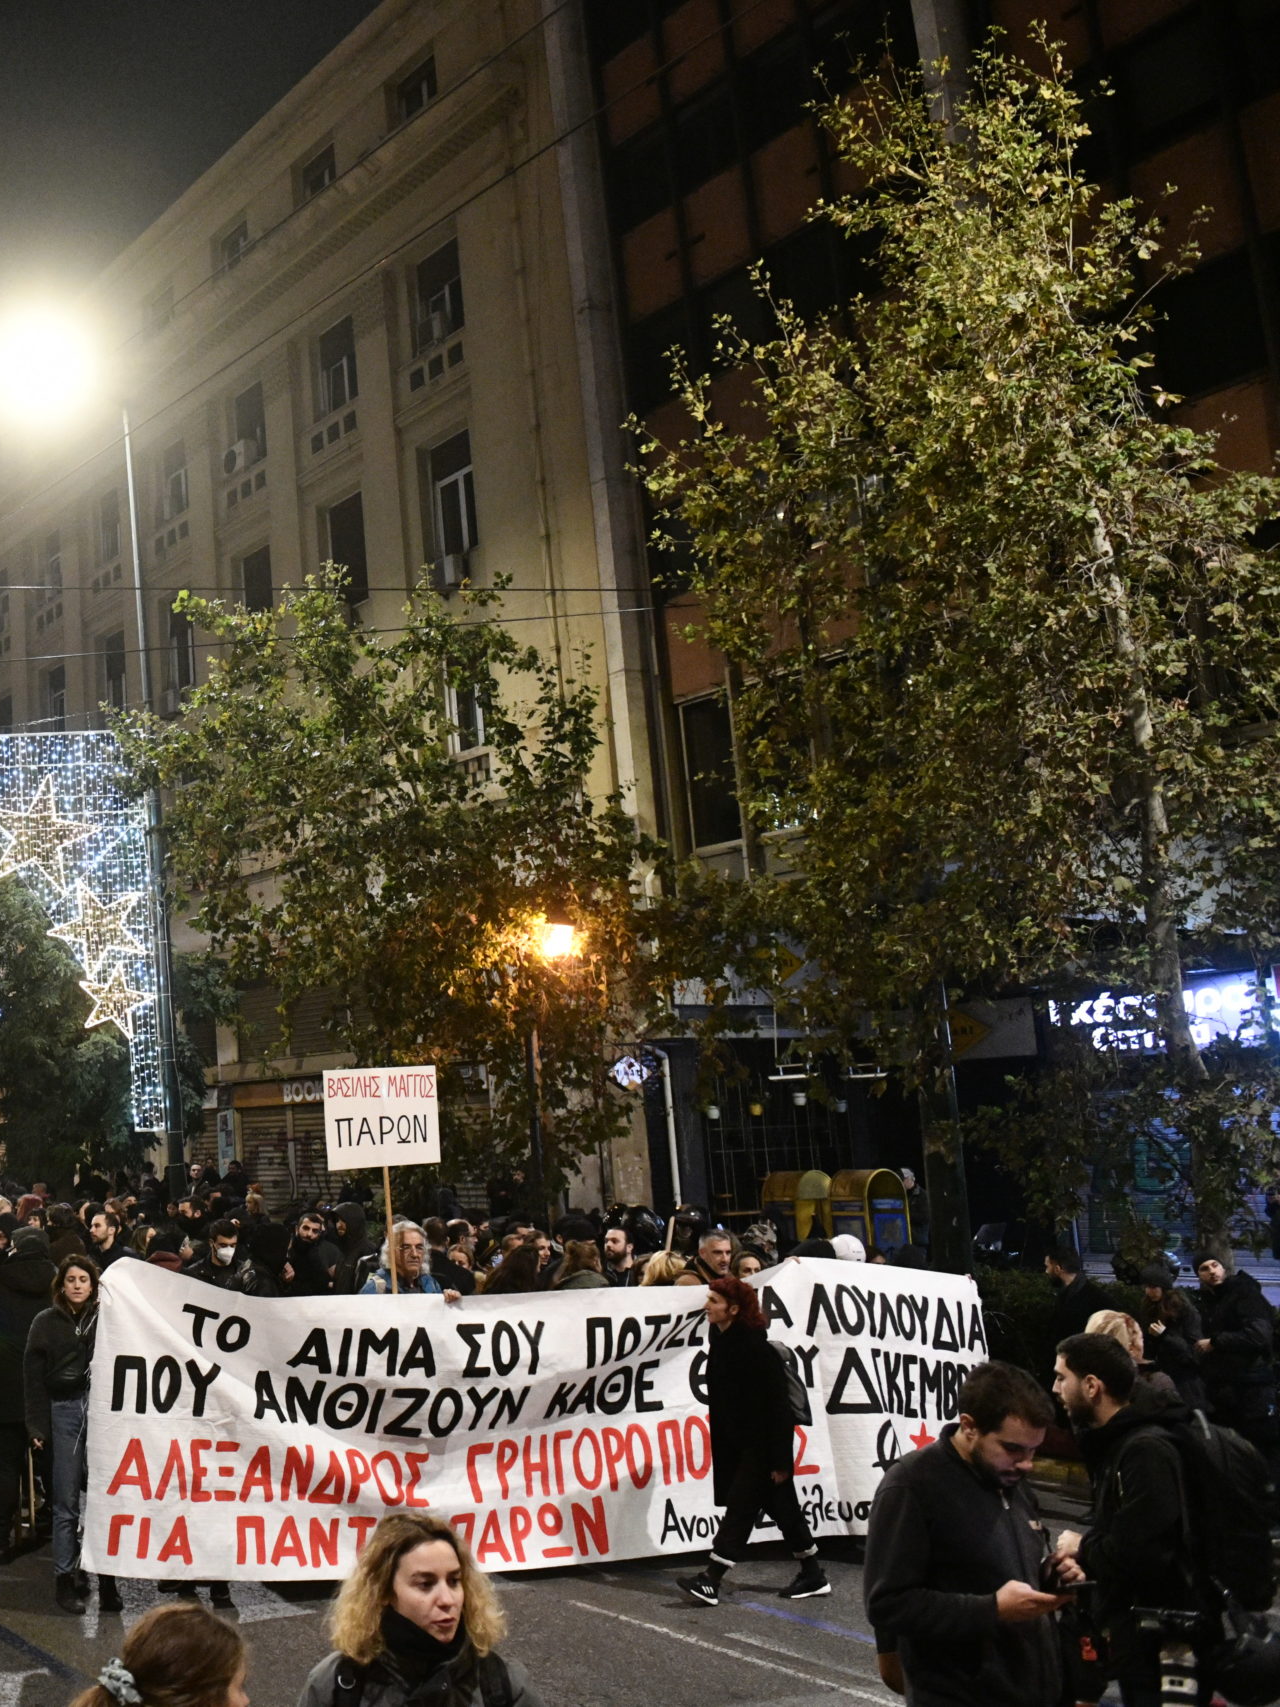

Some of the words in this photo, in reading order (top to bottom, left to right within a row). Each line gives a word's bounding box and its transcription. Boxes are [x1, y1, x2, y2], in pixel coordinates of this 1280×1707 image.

[327, 1076, 381, 1098] ΒΑΣΙΛΗΣ
[387, 1074, 435, 1098] ΜΑΓΓΟΣ
[335, 1114, 427, 1148] ΠΑΡΩΝ
[182, 1303, 251, 1353] ΤΟ
[286, 1327, 436, 1378] ΑΙΜΑ
[456, 1320, 545, 1378] ΣΟΥ
[806, 1283, 988, 1356] ΛΟΥΛΟΥΔΙΑ
[111, 1355, 221, 1418] ΠΟΥ
[254, 1370, 531, 1438] ΑΝΘΙΖΟΥΝ
[543, 1358, 665, 1420] ΚΑΘΕ
[106, 1438, 431, 1508] ΑΛΕΞΑΝΔΡΟΣ
[107, 1514, 194, 1566] ΓΙΑ
[236, 1515, 378, 1568] ΠΑΝΤ
